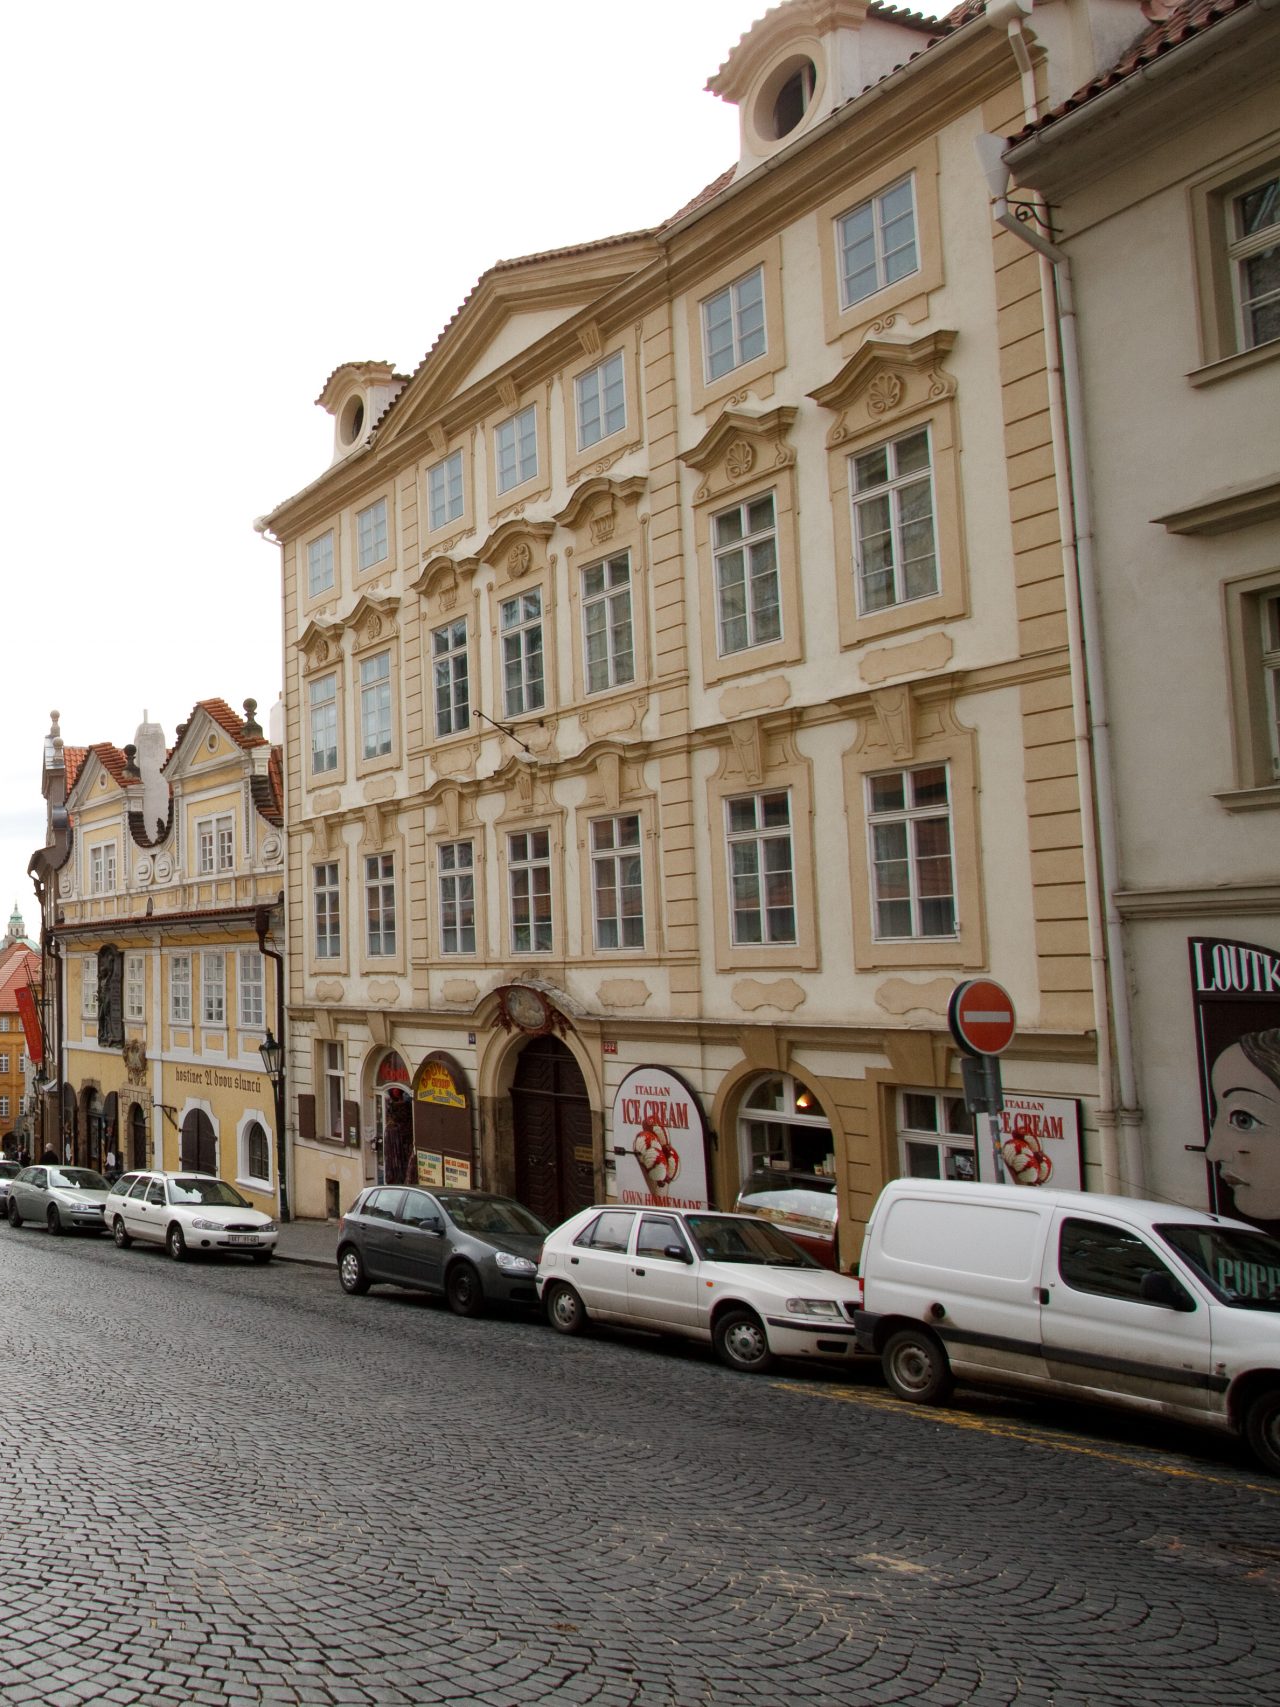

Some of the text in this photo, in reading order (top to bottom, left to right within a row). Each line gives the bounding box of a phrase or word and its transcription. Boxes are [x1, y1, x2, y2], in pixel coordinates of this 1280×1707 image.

[1193, 943, 1280, 991] LOUTK
[175, 1067, 202, 1085] hostinec
[635, 1085, 671, 1097] ITALIAN
[622, 1099, 690, 1130] ICE CREAM
[1005, 1100, 1045, 1111] ITALIAN
[1014, 1113, 1065, 1140] CREAM
[622, 1189, 643, 1205] OWN
